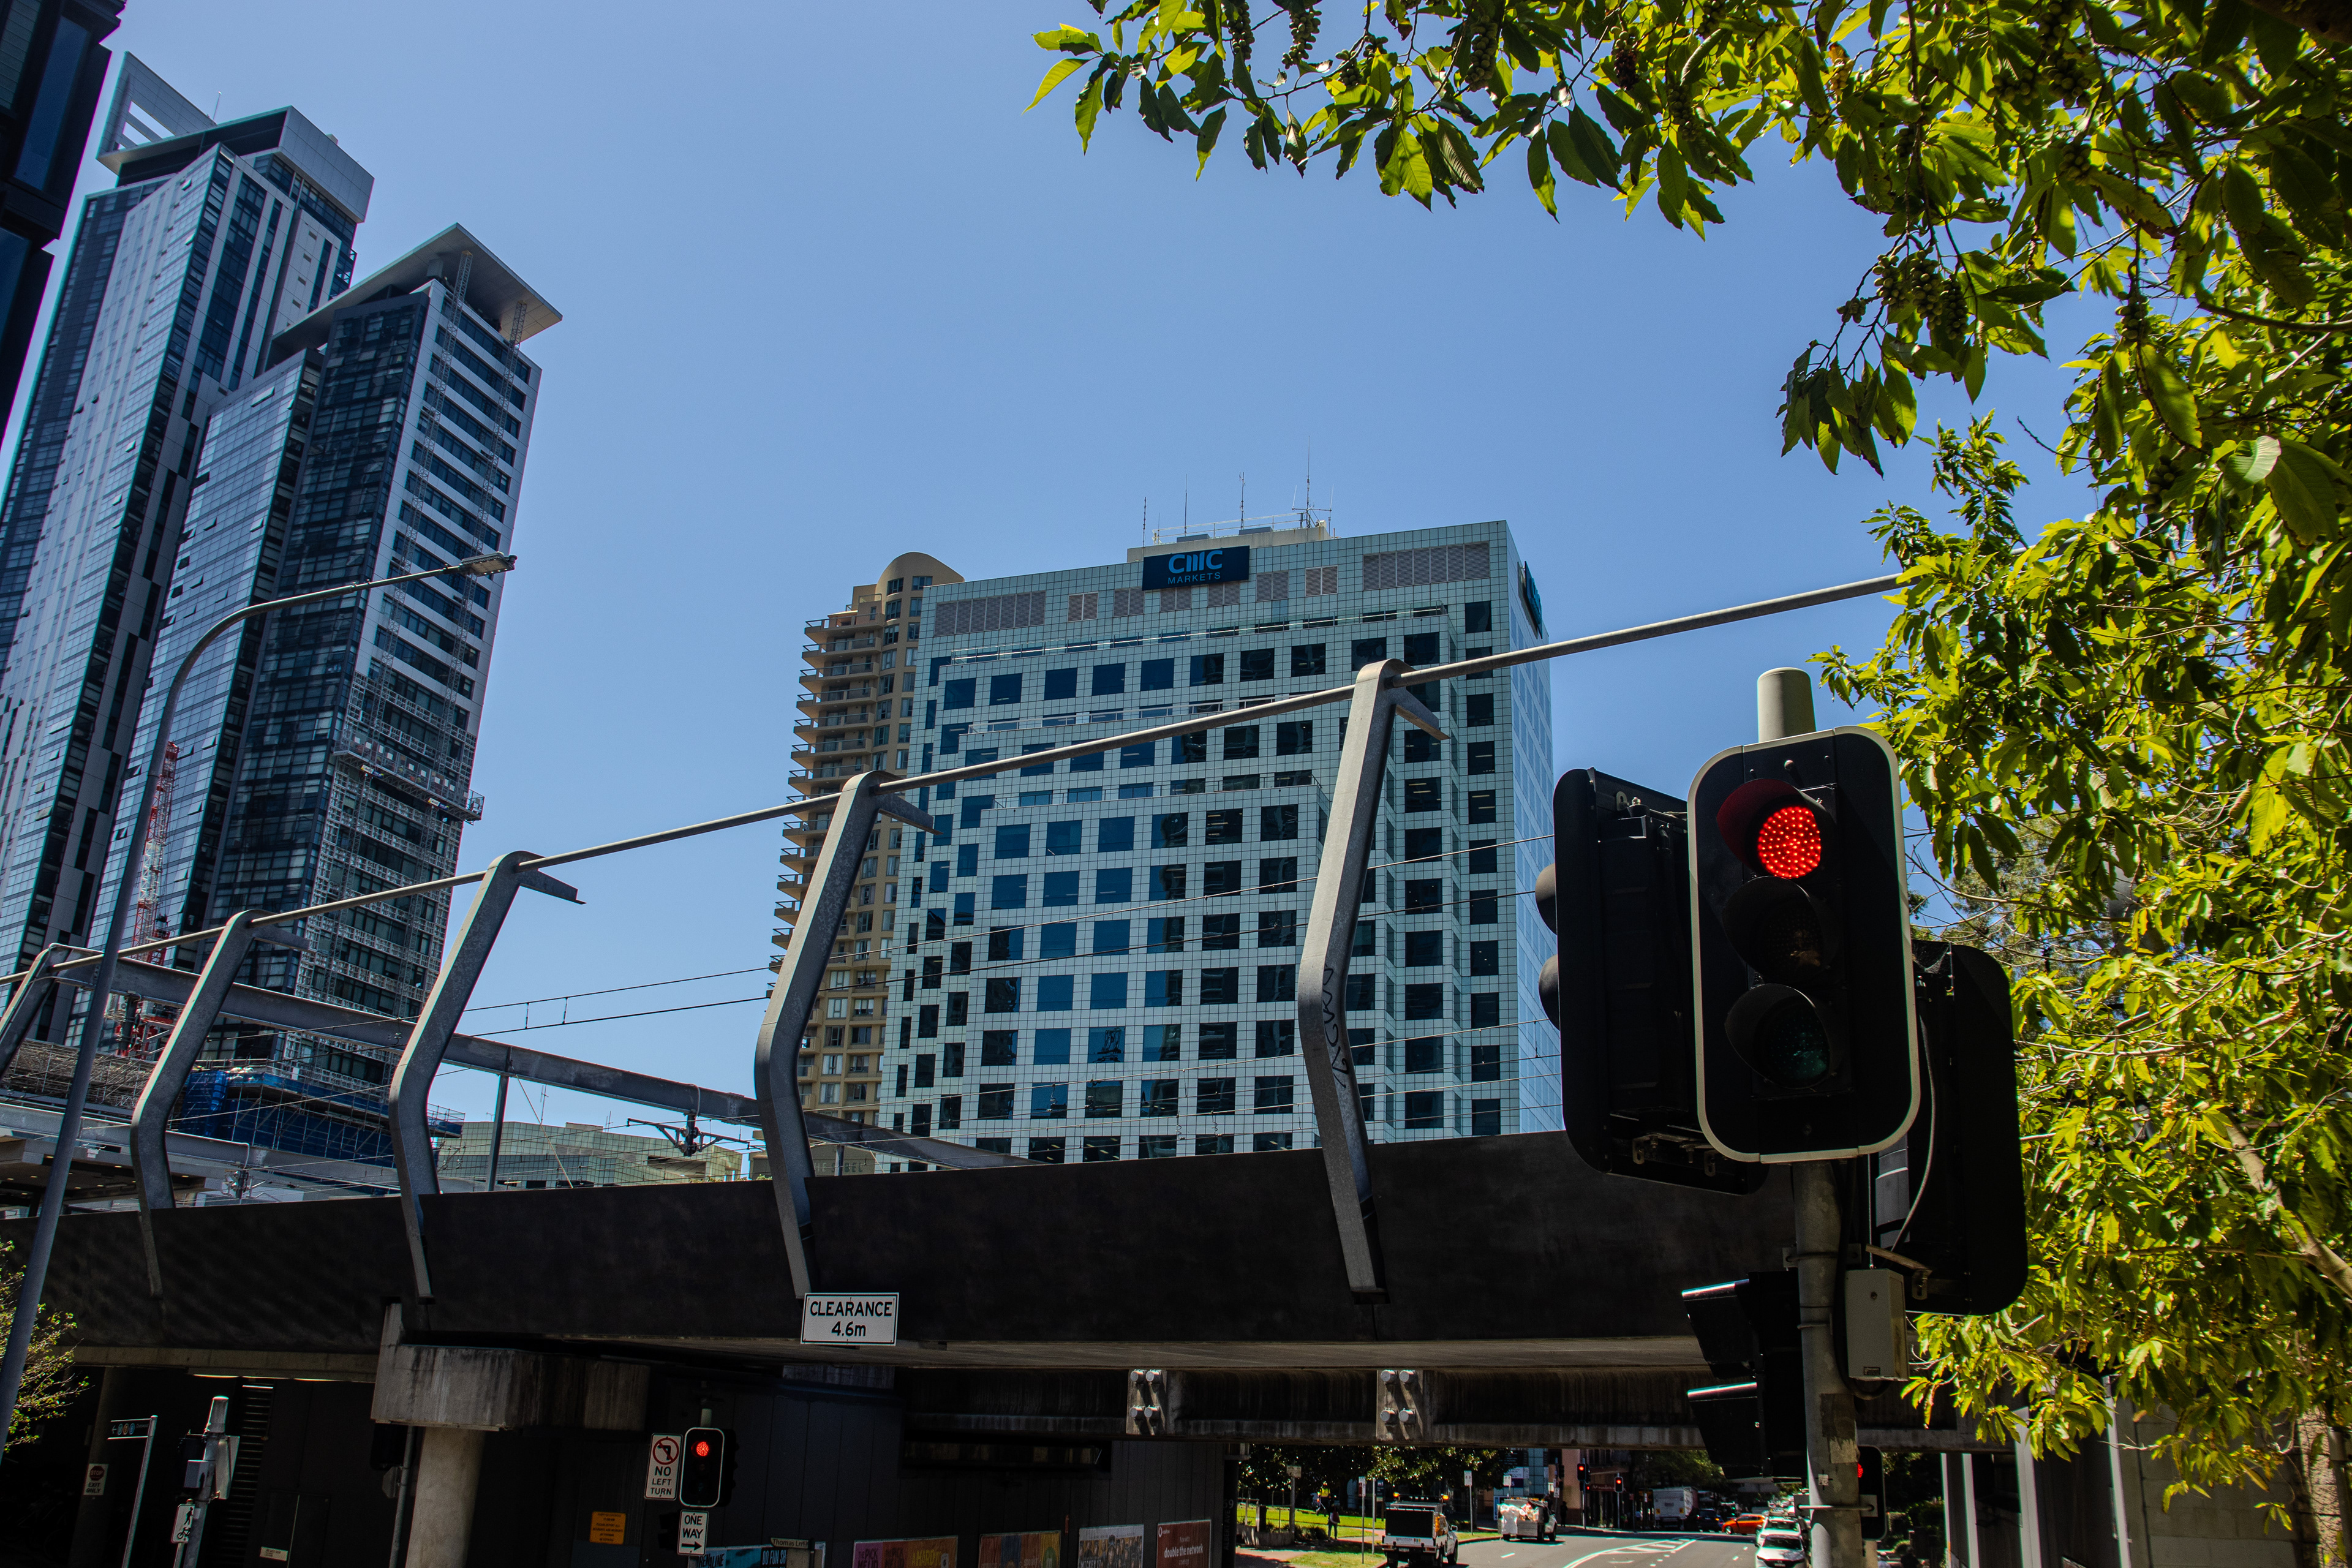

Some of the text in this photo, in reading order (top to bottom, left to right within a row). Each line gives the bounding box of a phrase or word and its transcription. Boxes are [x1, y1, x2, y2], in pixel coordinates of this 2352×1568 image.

[1168, 550, 1223, 574] CMC
[1168, 572, 1221, 584] MARKETS
[814, 1161, 863, 1172] HE SBEL
[810, 1300, 892, 1316] CLEARANCE
[831, 1321, 866, 1336] 4.6m
[655, 1466, 671, 1477] NO
[685, 1515, 703, 1525] ONE
[682, 1528, 704, 1539] WAY
[865, 1548, 878, 1559] PICK
[1164, 1547, 1179, 1558] double
[1186, 1544, 1204, 1555] network
[762, 1550, 769, 1565] DO
[769, 1550, 779, 1564] FUN
